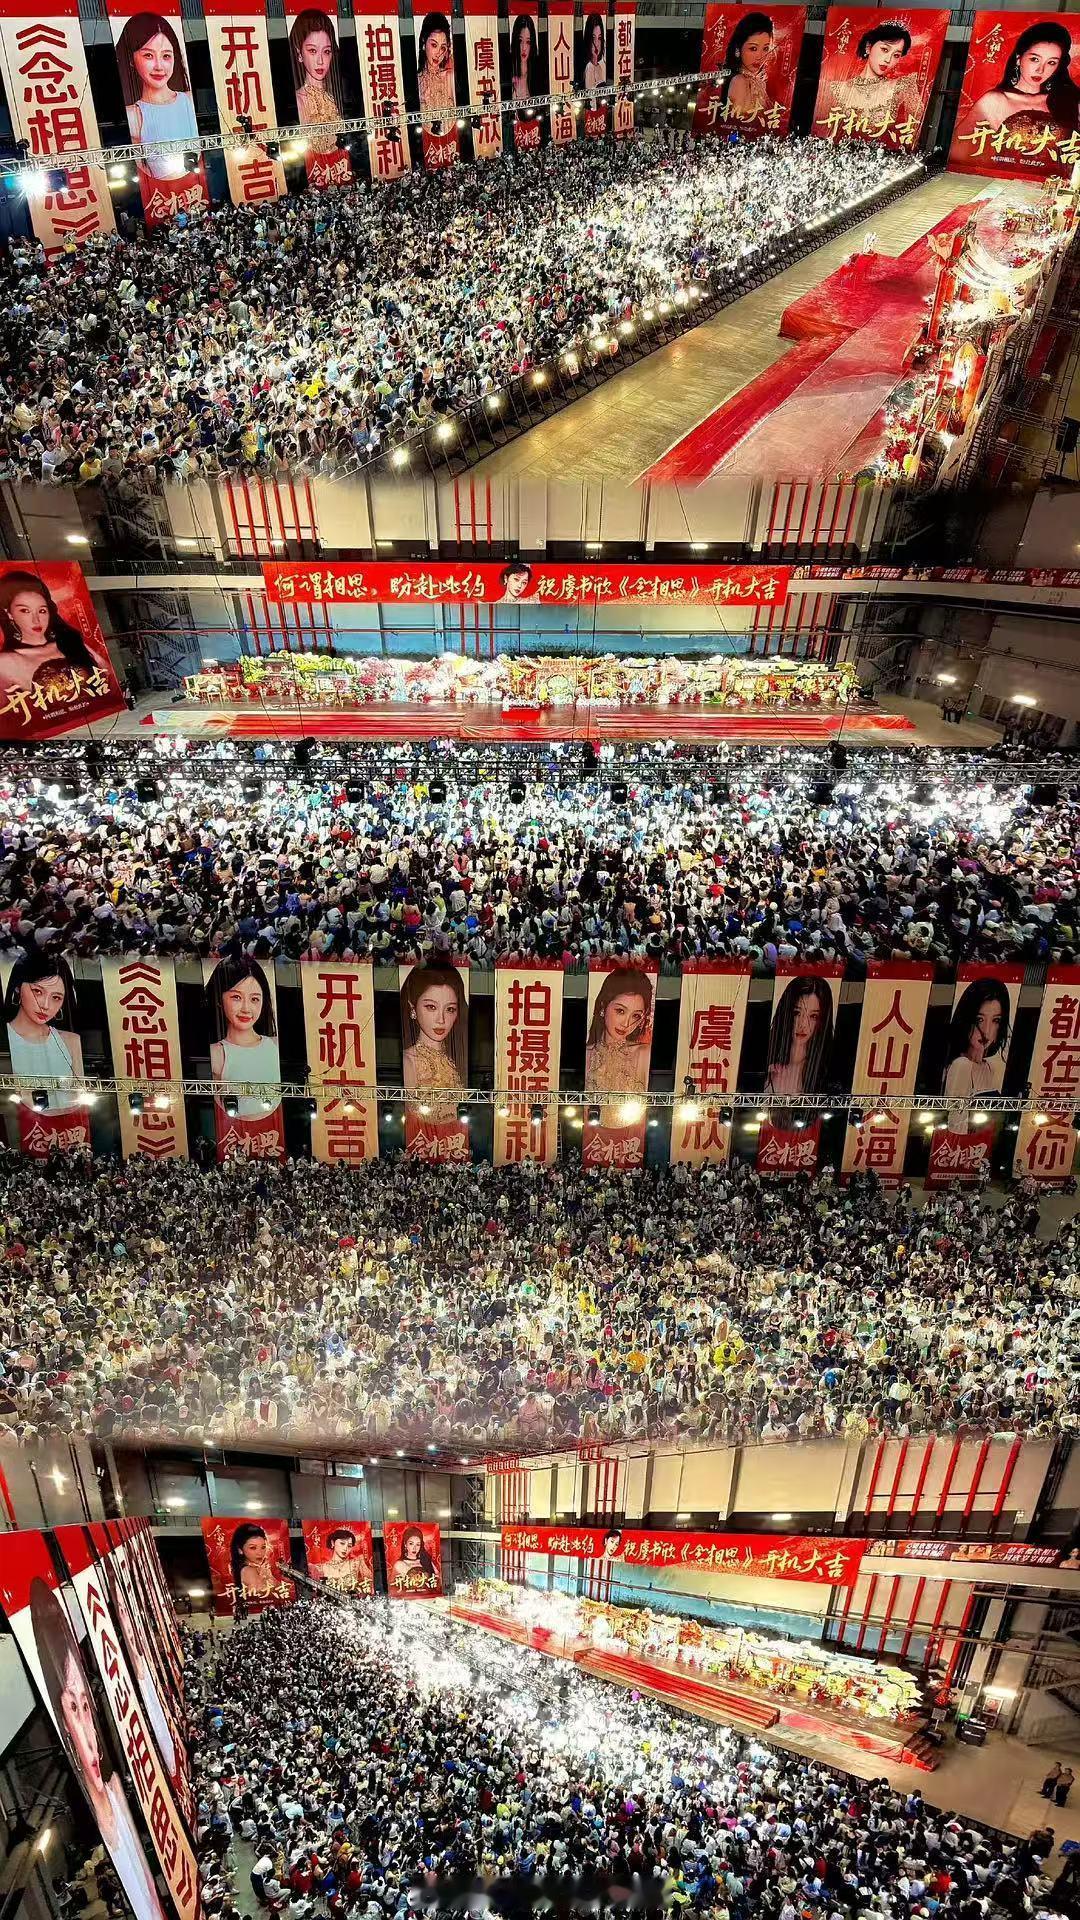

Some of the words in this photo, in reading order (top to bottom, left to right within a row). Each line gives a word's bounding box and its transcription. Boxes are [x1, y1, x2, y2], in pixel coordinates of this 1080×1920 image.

[829, 17, 852, 56] 念相思
[976, 22, 1004, 64] 念相思
[699, 95, 787, 129] 开机大吉
[816, 107, 923, 145] 开机大吉
[424, 141, 460, 164] 念相思
[958, 121, 1080, 164] 开机大吉
[308, 160, 352, 187] 念相思
[147, 184, 209, 219] 念相思
[0, 666, 109, 726] 开机大吉
[506, 979, 551, 1162] 拍摄顺利
[22, 1122, 92, 1154] 念相思
[217, 1125, 285, 1158] 念相思
[406, 1129, 469, 1162] 念相思
[583, 1133, 643, 1165] 念相思
[758, 1135, 818, 1168] 念相思
[930, 1138, 989, 1169] 念相思
[217, 1580, 291, 1605] 开机大吉
[390, 1573, 438, 1593] 开机大吉
